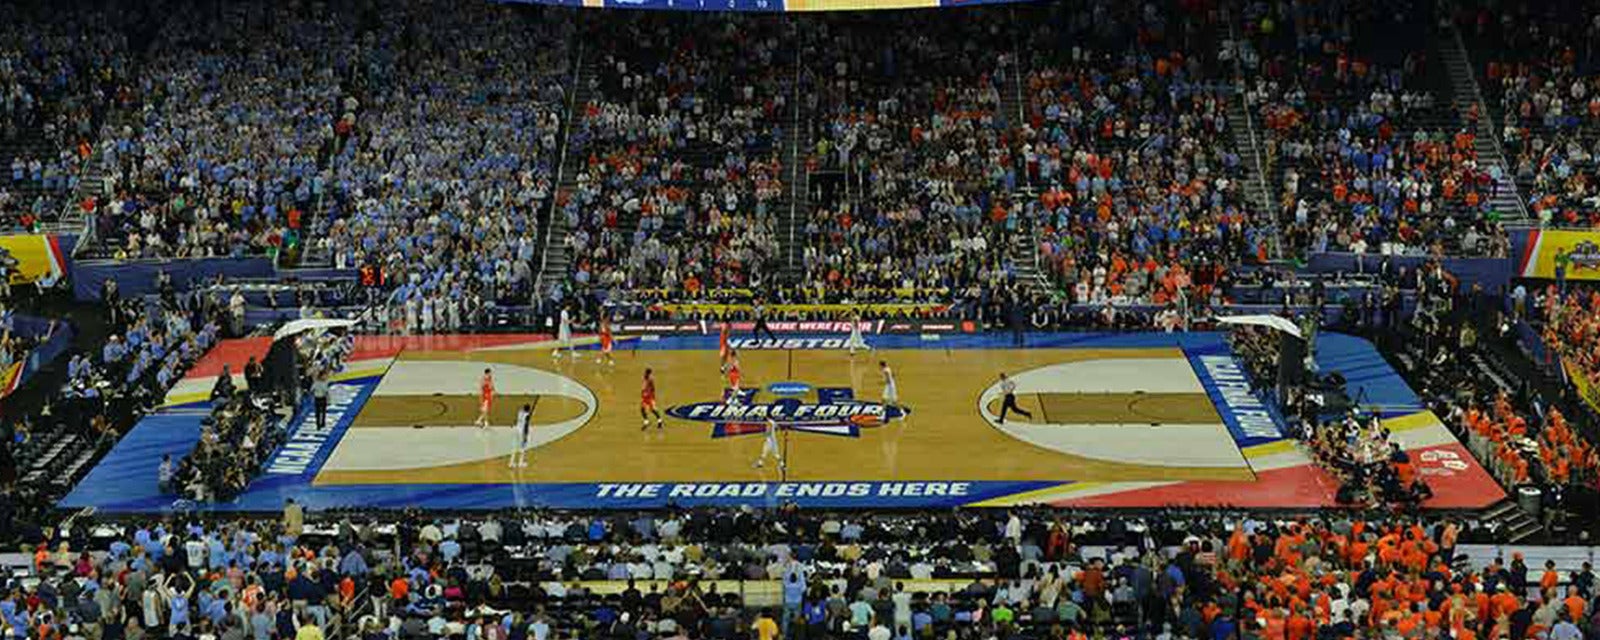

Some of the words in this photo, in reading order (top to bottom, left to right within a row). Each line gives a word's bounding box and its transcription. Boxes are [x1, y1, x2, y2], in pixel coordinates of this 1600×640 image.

[688, 404, 788, 418] FINAL
[794, 404, 884, 418] FOUR
[596, 484, 664, 497] THE
[668, 484, 768, 497] ROAD
[774, 483, 872, 497] ENDS
[878, 483, 970, 497] HERE
